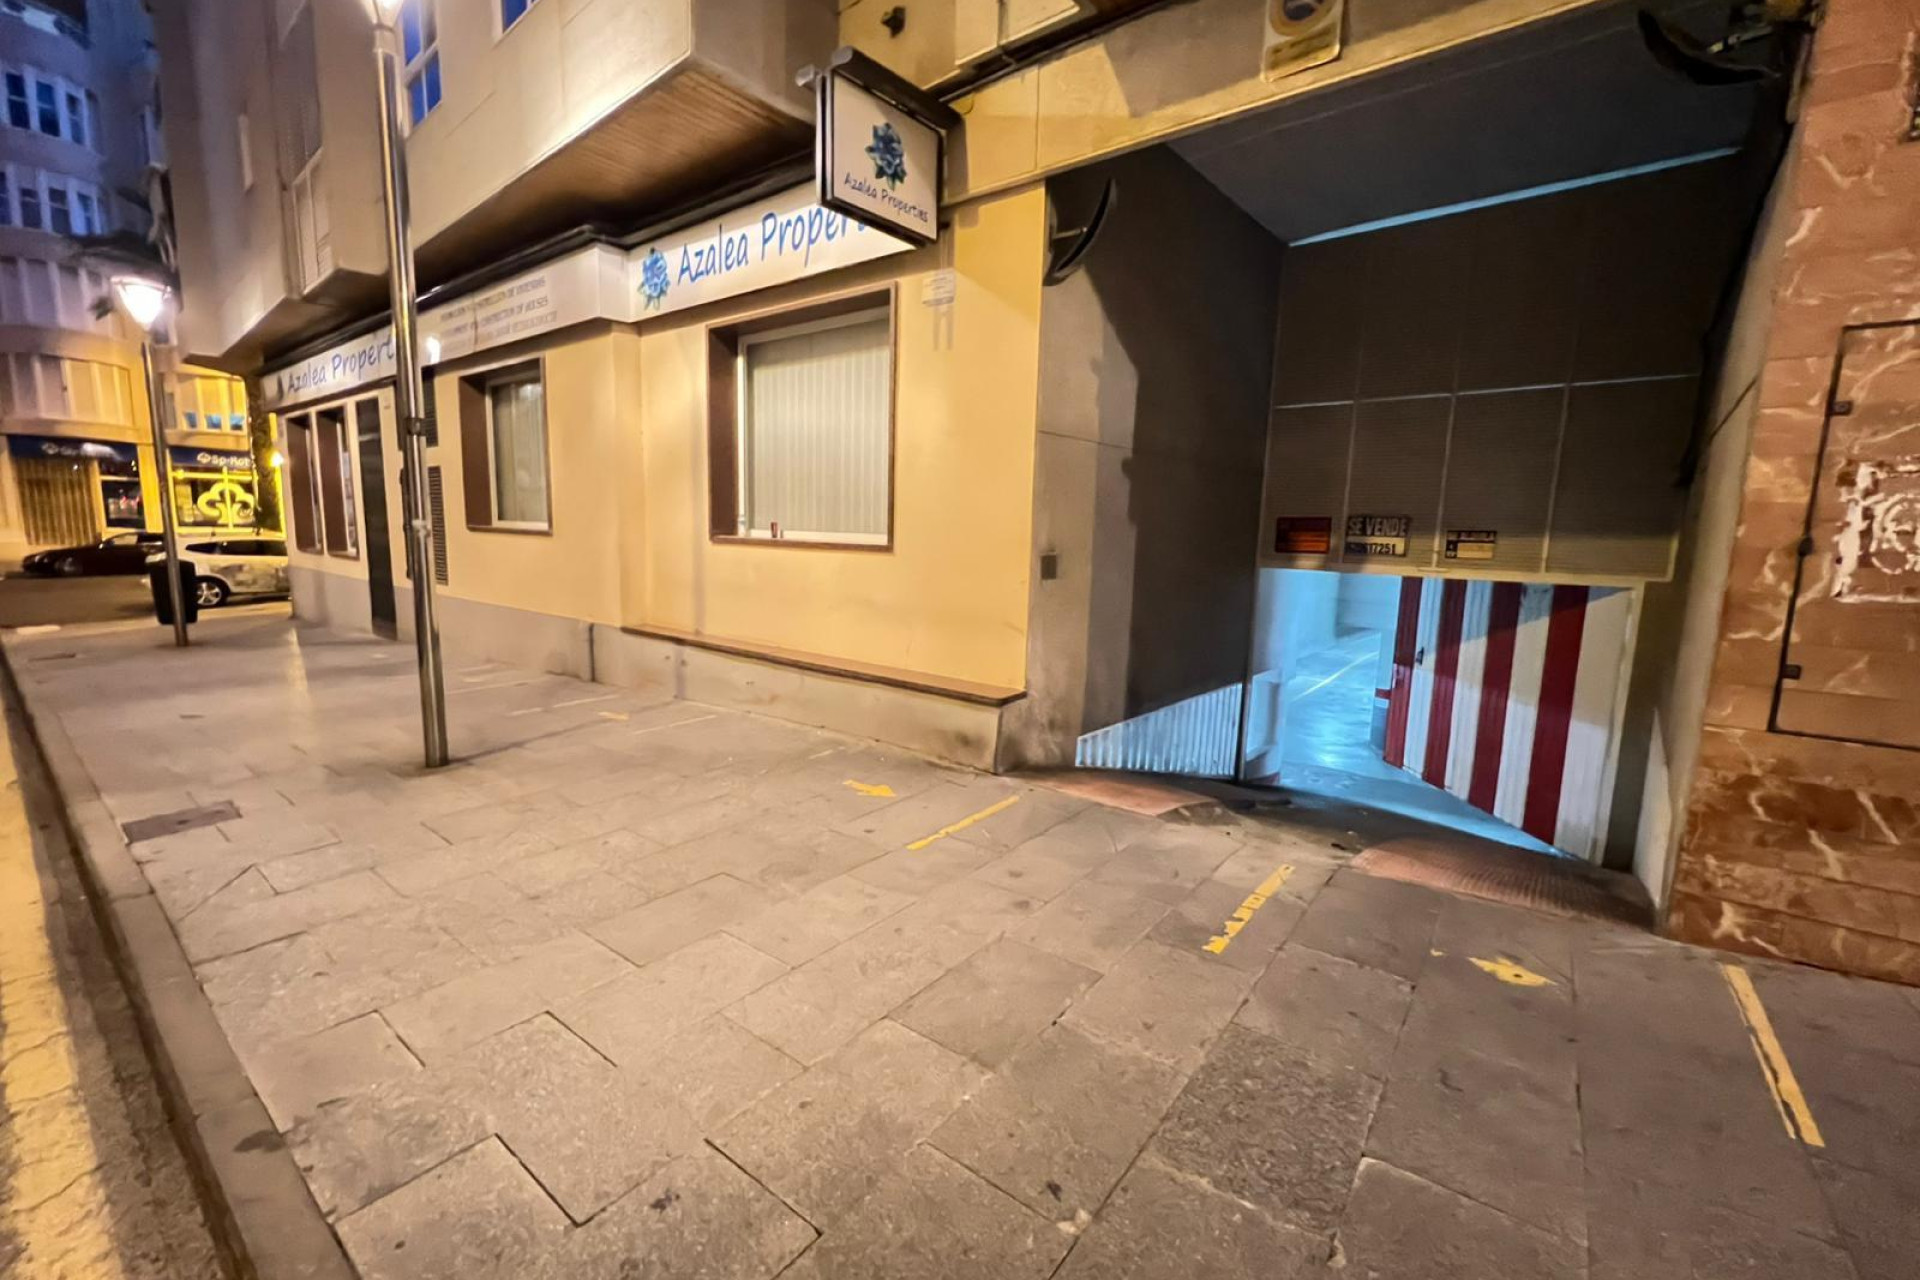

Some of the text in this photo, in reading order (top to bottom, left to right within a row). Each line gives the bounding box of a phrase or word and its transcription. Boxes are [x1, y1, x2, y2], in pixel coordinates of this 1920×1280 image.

[844, 172, 928, 223] Azalea Properties
[678, 223, 749, 285] Azalea
[287, 362, 327, 395] Azalea
[1365, 517, 1408, 537] VENDE
